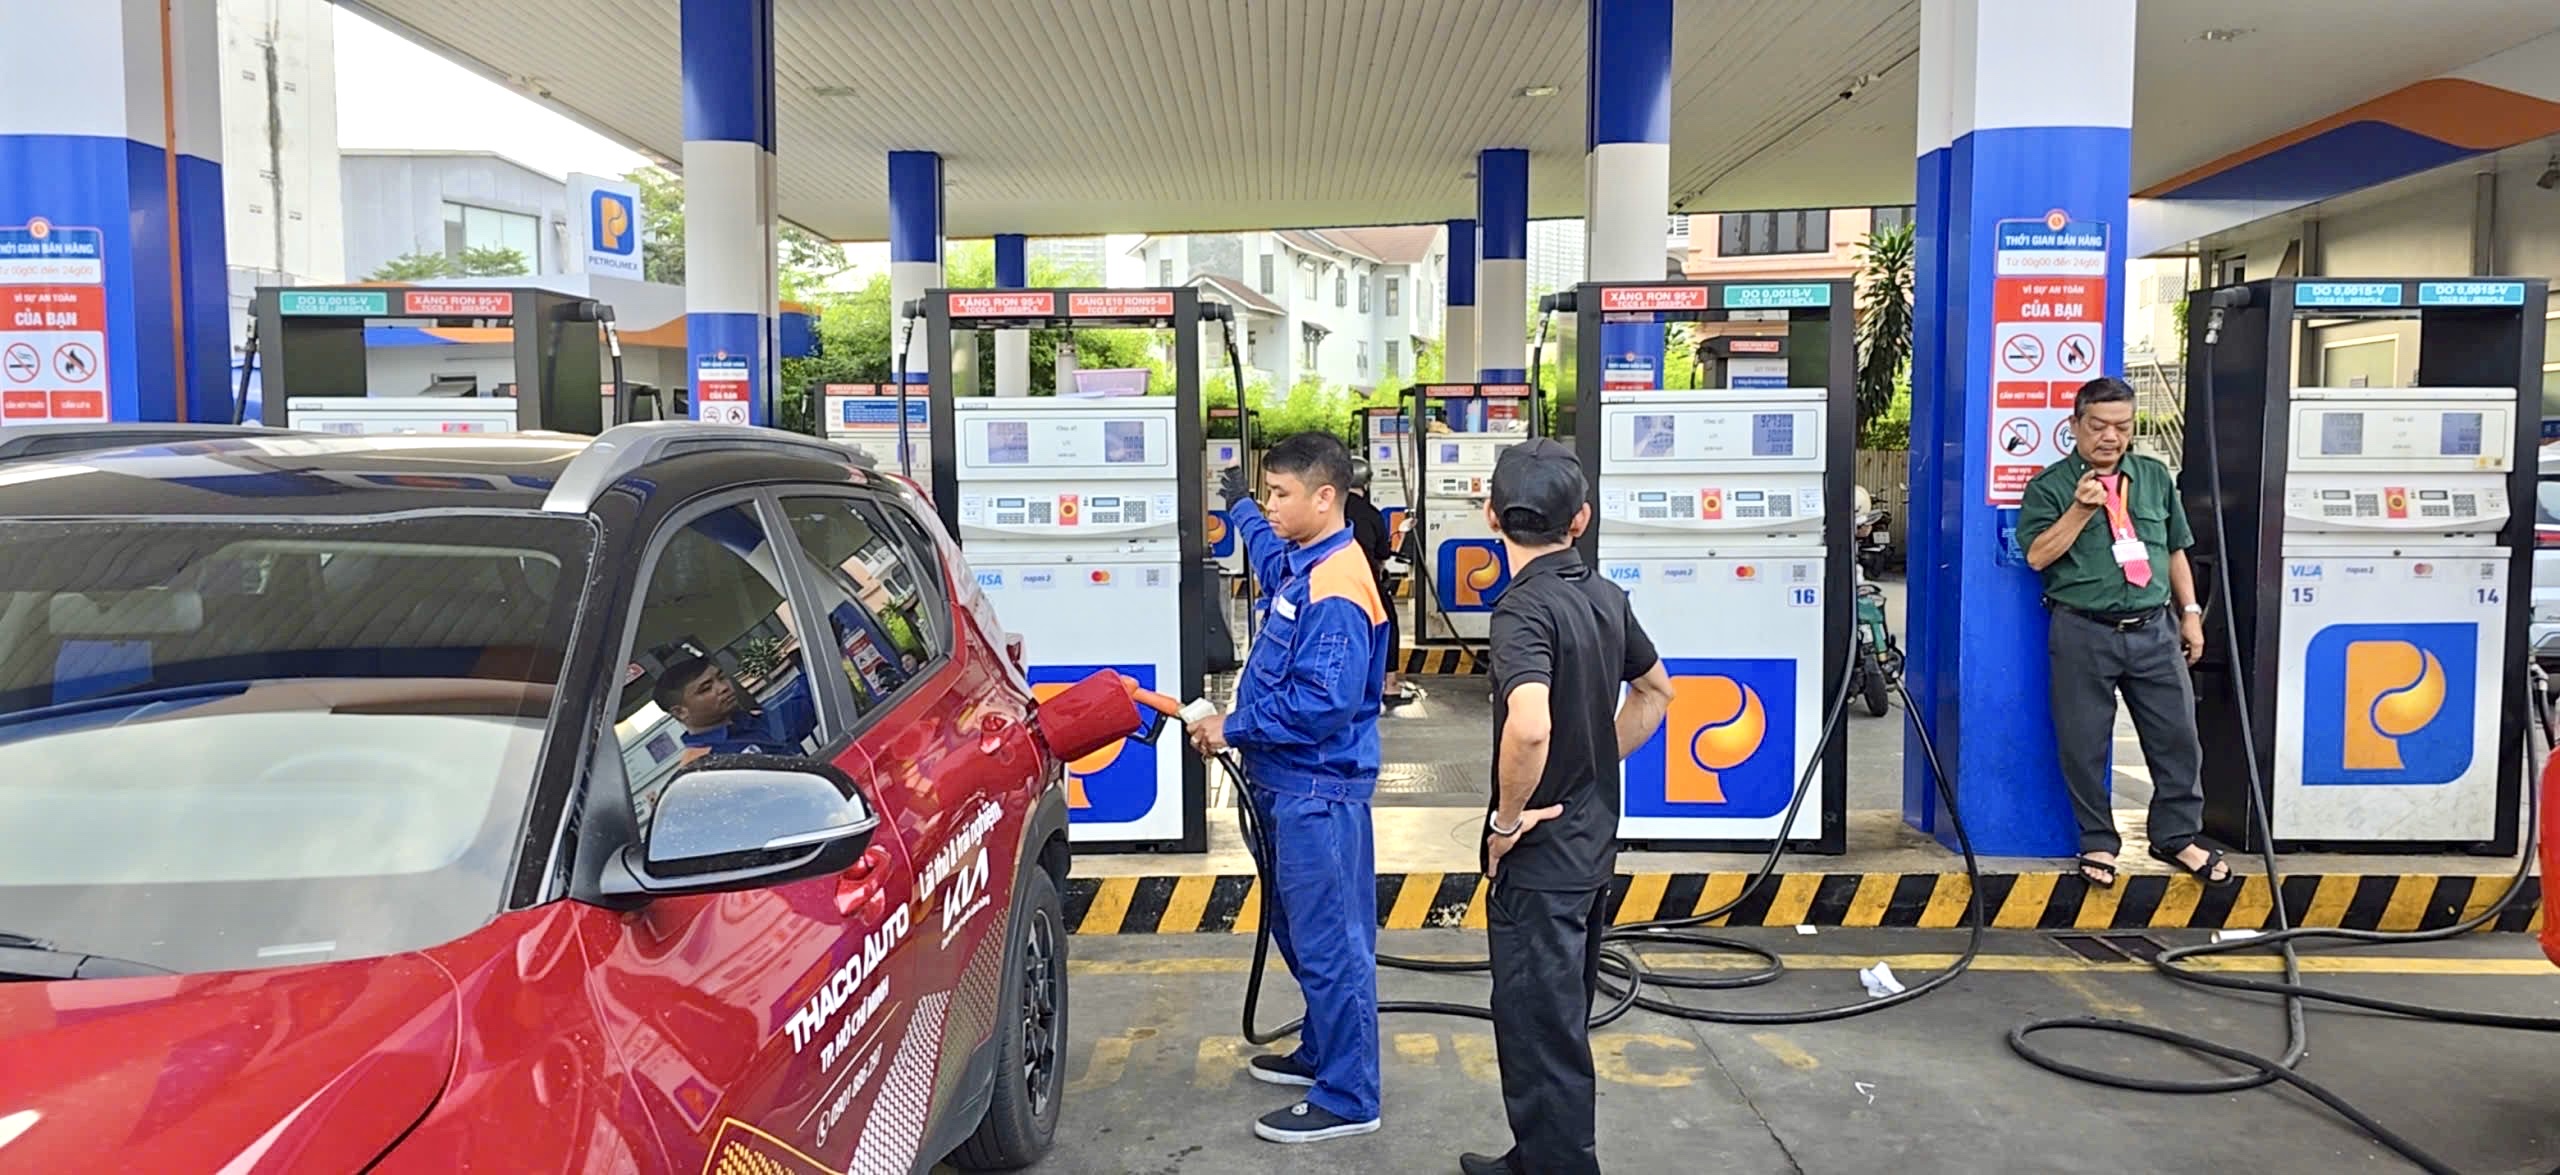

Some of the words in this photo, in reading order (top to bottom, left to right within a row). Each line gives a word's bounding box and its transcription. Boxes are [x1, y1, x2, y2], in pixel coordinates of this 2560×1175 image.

[0, 241, 17, 254] HỜI
[2031, 235, 2055, 246] GIAN
[588, 256, 638, 271] PETROLIMEX
[298, 296, 316, 305] DO
[451, 295, 476, 305] RON
[1646, 291, 1672, 301] RON
[1741, 289, 1760, 299] DO
[993, 297, 1018, 306] RON
[2021, 299, 2050, 318] CỦA
[2054, 303, 2083, 320] BẠN
[15, 307, 43, 326] CỦA
[46, 311, 77, 329] BẠN
[1610, 568, 1640, 579] VISA
[1794, 588, 1816, 604] 16
[2292, 587, 2314, 603] 15
[2478, 588, 2499, 604] 14
[942, 847, 989, 932] KIA
[784, 954, 862, 1054] THACO
[863, 902, 910, 980] AUTO
